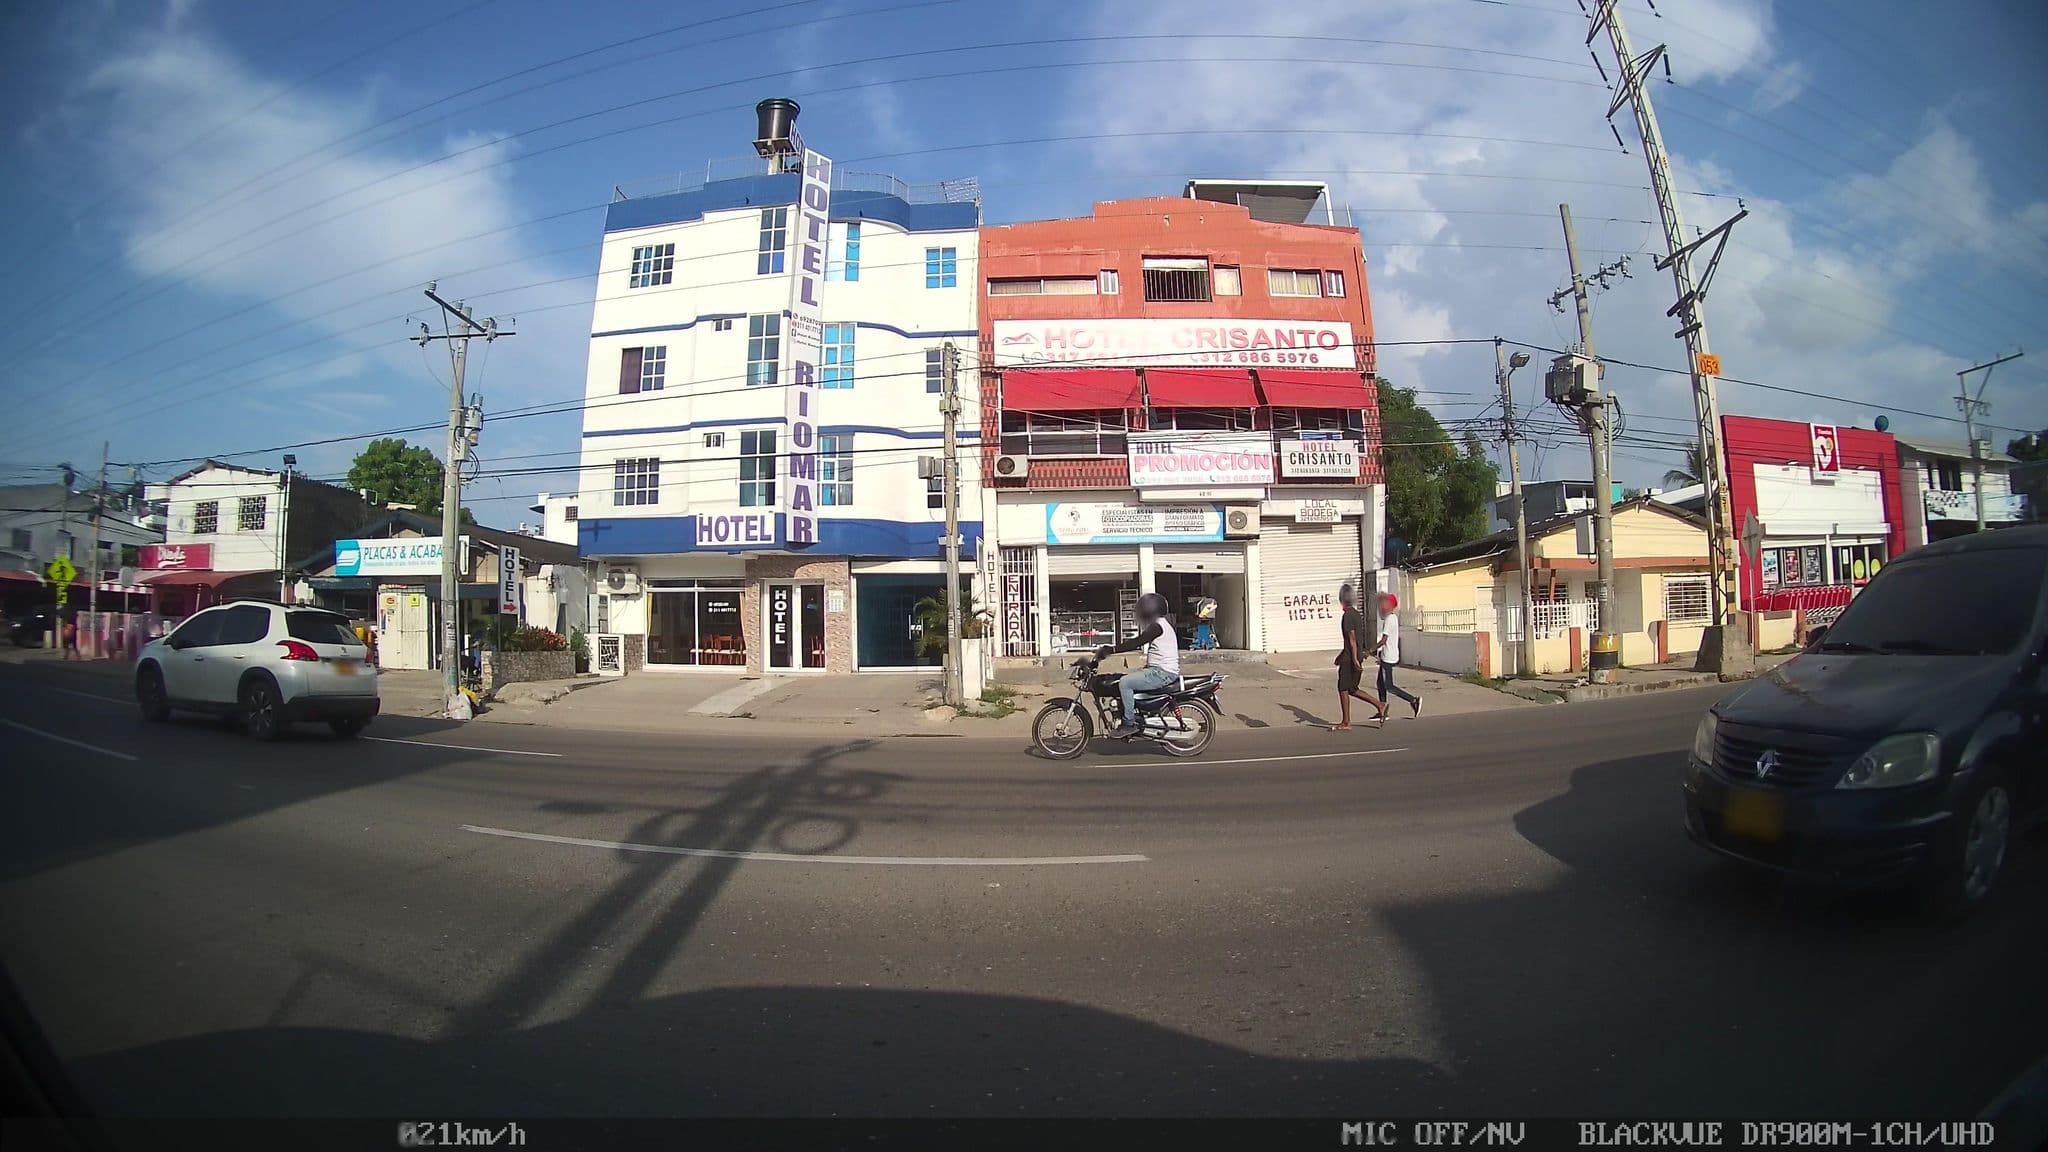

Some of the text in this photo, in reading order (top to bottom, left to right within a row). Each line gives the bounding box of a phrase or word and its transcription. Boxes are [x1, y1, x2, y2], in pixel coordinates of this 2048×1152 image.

[800, 152, 830, 307] HOTEL
[1044, 328, 1340, 350] HOT CRISANTO
[1200, 352, 1233, 363] 312
[1238, 353, 1271, 363] 686
[1277, 353, 1319, 364] 5976
[1700, 359, 1718, 375] 053
[789, 360, 815, 543] RIOMAR
[1136, 442, 1174, 454] HOTEL
[1303, 442, 1337, 452] HOTEL
[1134, 449, 1270, 472] PROMOCIÓN
[1290, 453, 1351, 465] CRISANTO
[1305, 499, 1337, 508] LOCAL
[1300, 508, 1339, 518] BODEGA
[699, 515, 772, 542] HOTEL
[363, 546, 397, 560] PLACAS
[400, 545, 406, 559] &
[505, 548, 515, 602] HOTEL
[987, 551, 996, 603] HOTEL
[1008, 575, 1020, 639] ENTRADA
[1284, 593, 1331, 607] GARAJE
[774, 590, 787, 644] HOTEL
[1289, 607, 1333, 621] HOTEL
